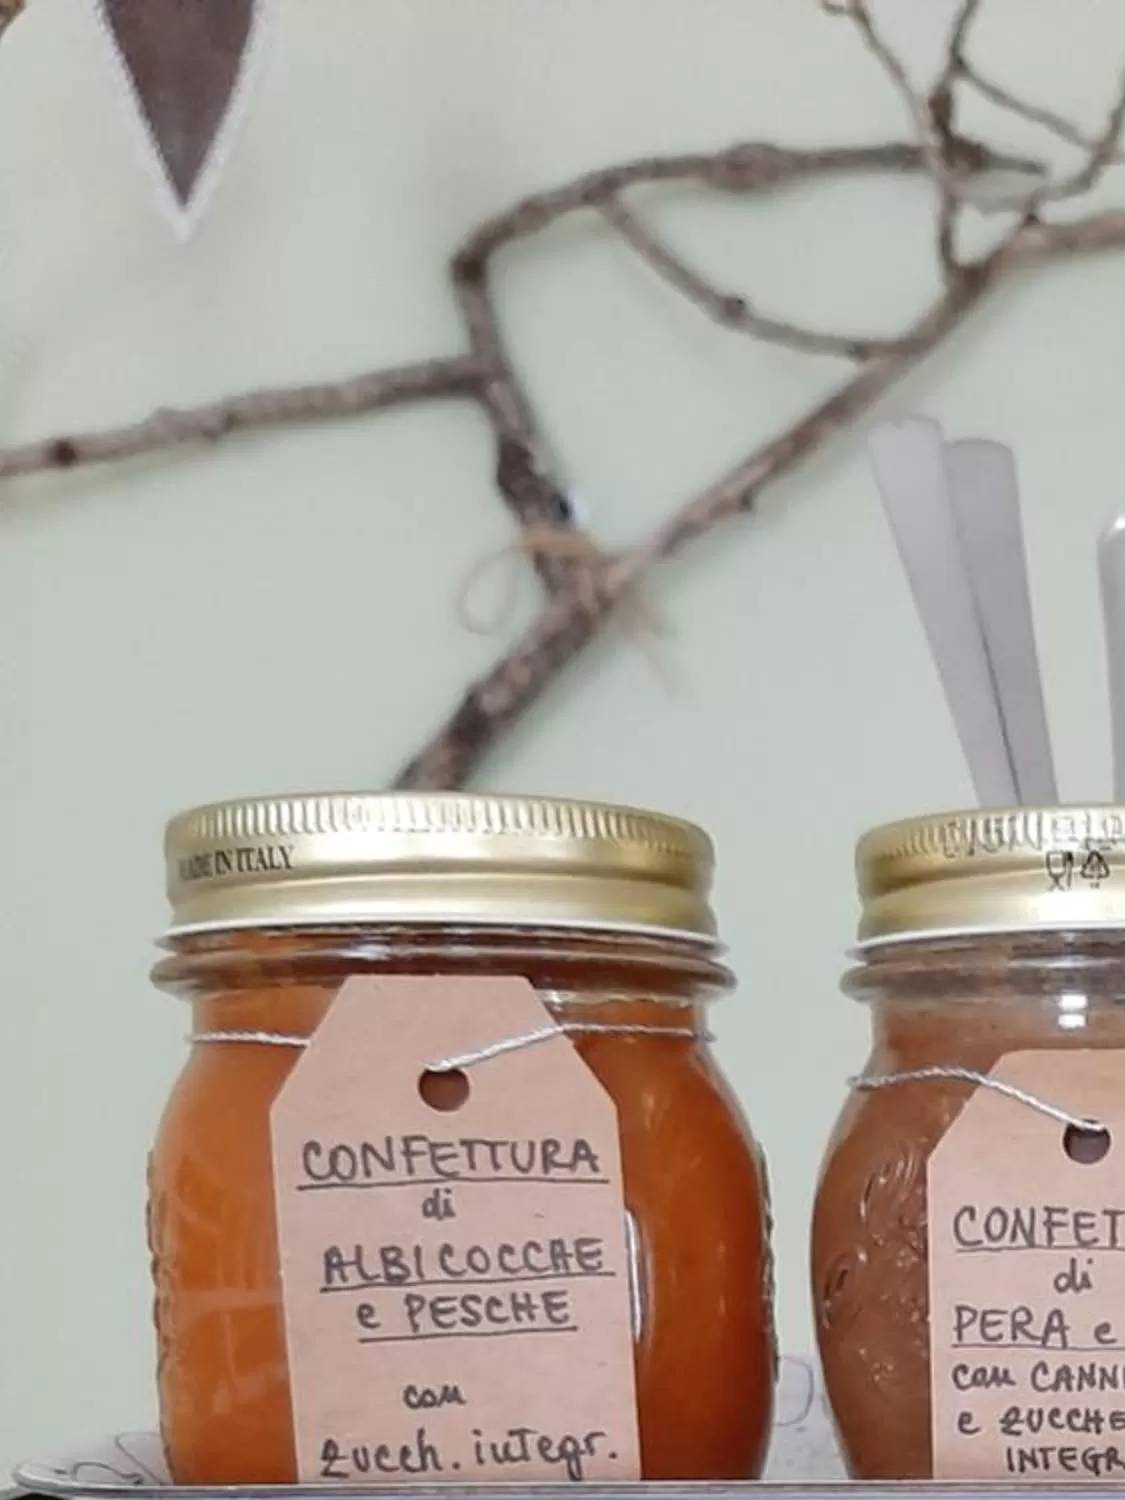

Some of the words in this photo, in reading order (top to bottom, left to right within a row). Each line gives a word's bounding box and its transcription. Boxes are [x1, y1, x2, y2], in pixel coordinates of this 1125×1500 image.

[235, 843, 296, 873] ITALY
[303, 1135, 600, 1181] CONFETTURA
[422, 1188, 455, 1220] di
[1054, 1257, 1093, 1293] di
[357, 1301, 381, 1329] e
[404, 1290, 569, 1332] PESCHE
[954, 1305, 1070, 1348] PERA
[1094, 1322, 1117, 1345] e
[958, 1411, 981, 1435] e
